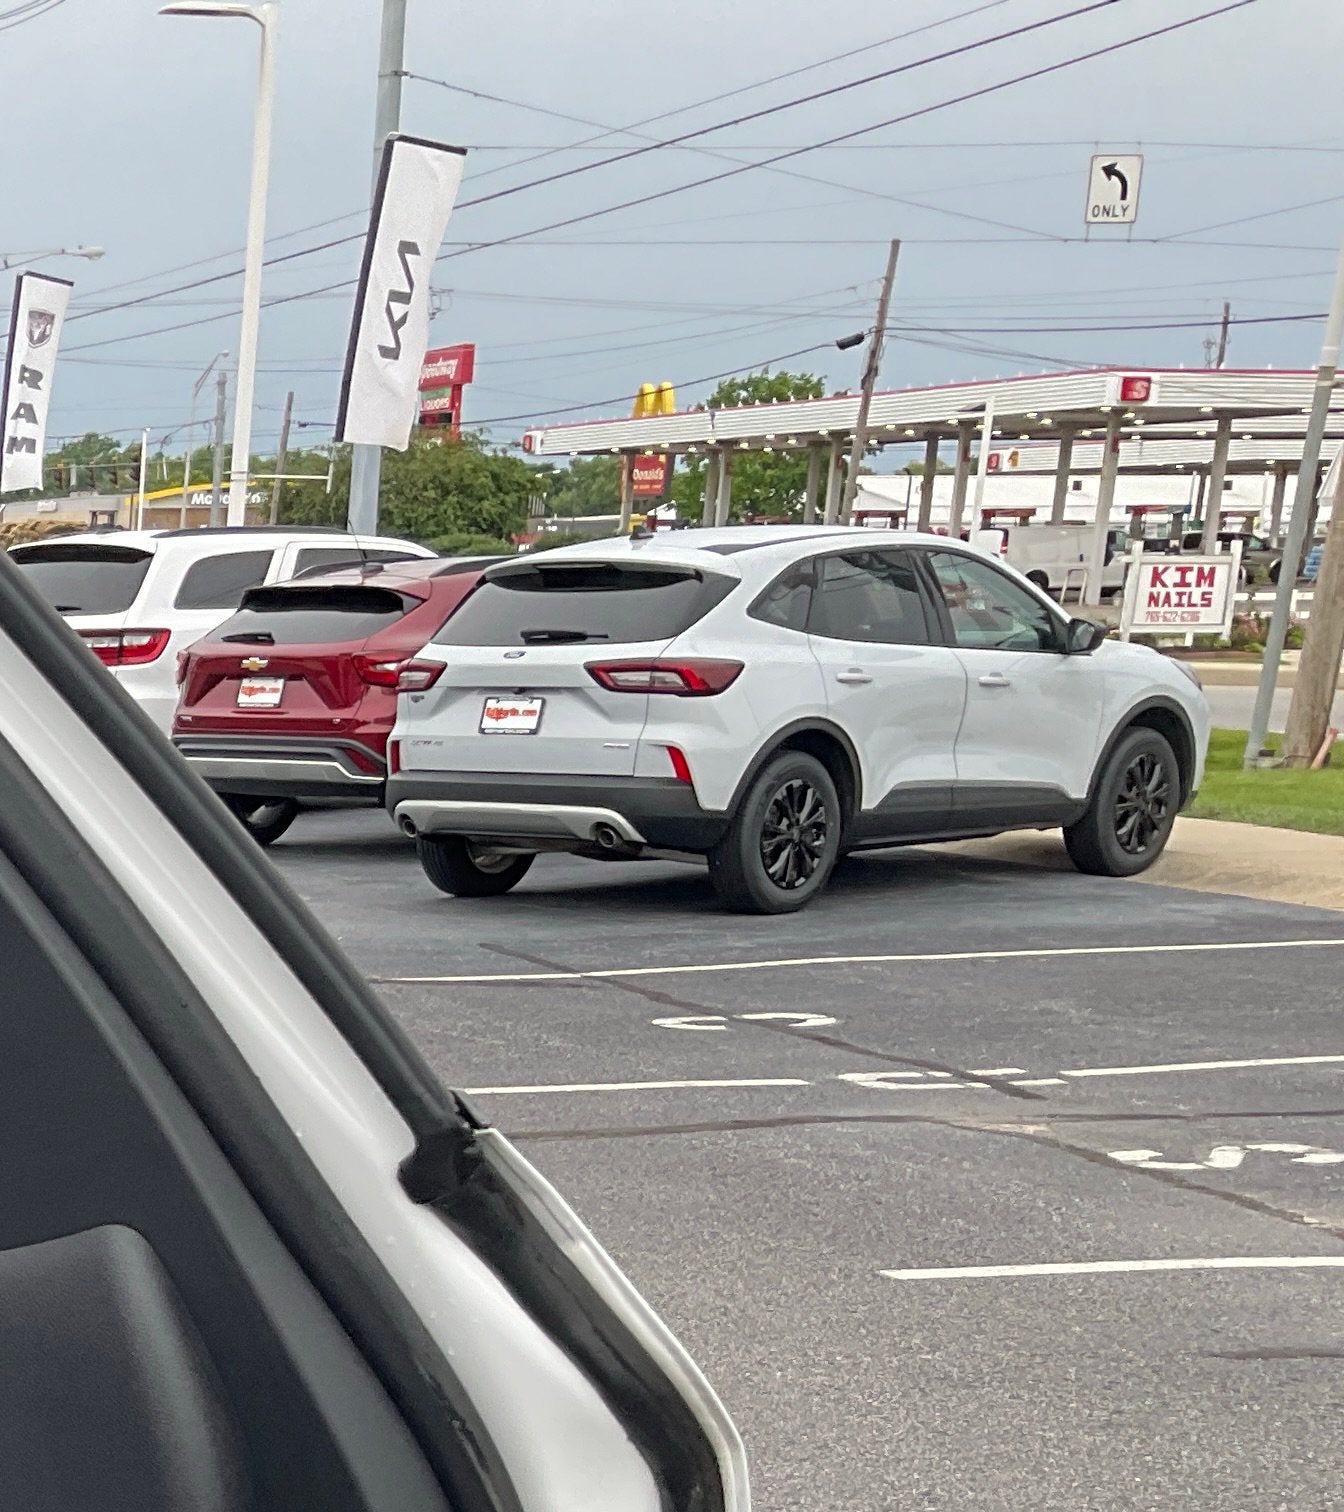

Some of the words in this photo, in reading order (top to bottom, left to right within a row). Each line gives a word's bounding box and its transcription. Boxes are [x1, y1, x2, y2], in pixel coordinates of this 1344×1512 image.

[1092, 205, 1129, 218] ONLY
[5, 364, 43, 454] RAM
[1150, 566, 1216, 588] KIM
[1147, 591, 1214, 608] NAILS
